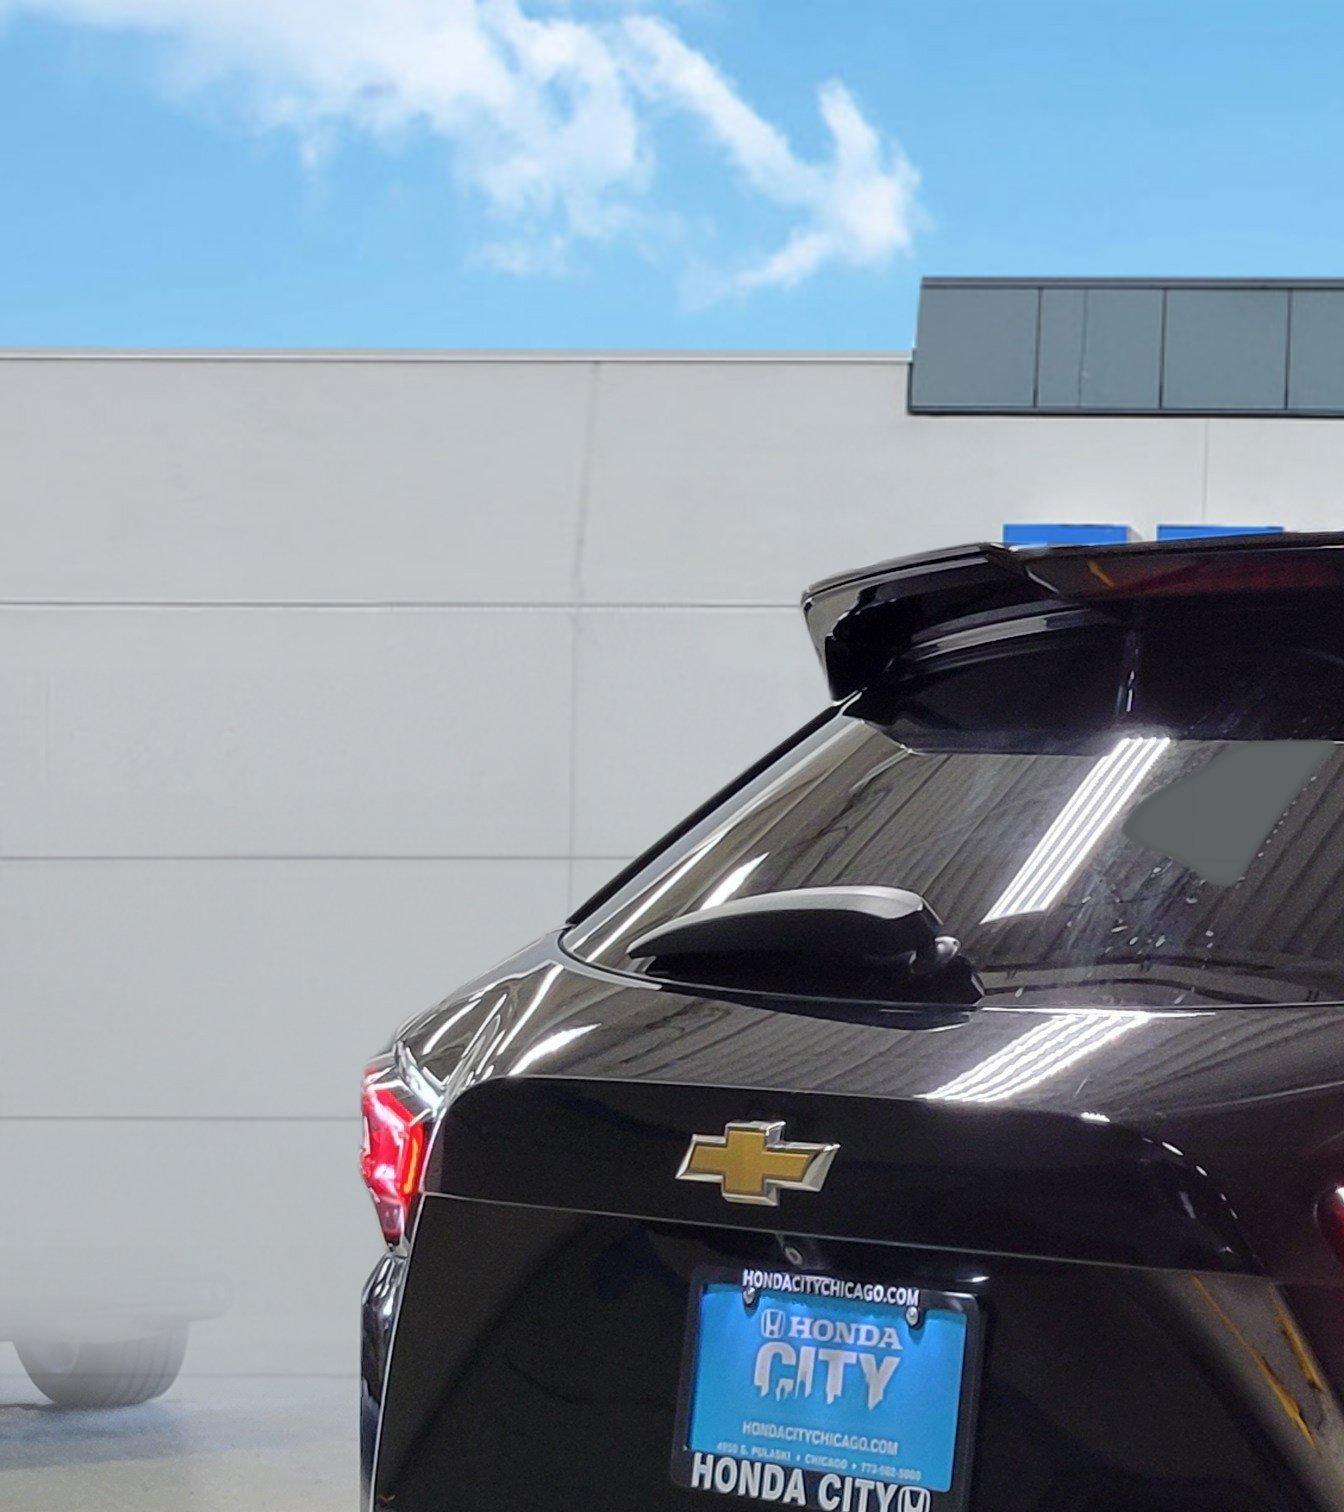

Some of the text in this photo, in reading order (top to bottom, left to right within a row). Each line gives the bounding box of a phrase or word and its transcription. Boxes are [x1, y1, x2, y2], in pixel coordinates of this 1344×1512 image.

[742, 1268, 920, 1307] HONDACITYCHICAGO.COM
[787, 1315, 904, 1351] HONDA
[753, 1341, 902, 1411] CITY
[741, 1420, 899, 1457] HONDACITYCHICAGO.COM
[751, 1446, 791, 1462] PULASKI
[804, 1452, 848, 1470] CHICAGO
[691, 1452, 807, 1506] HONDA
